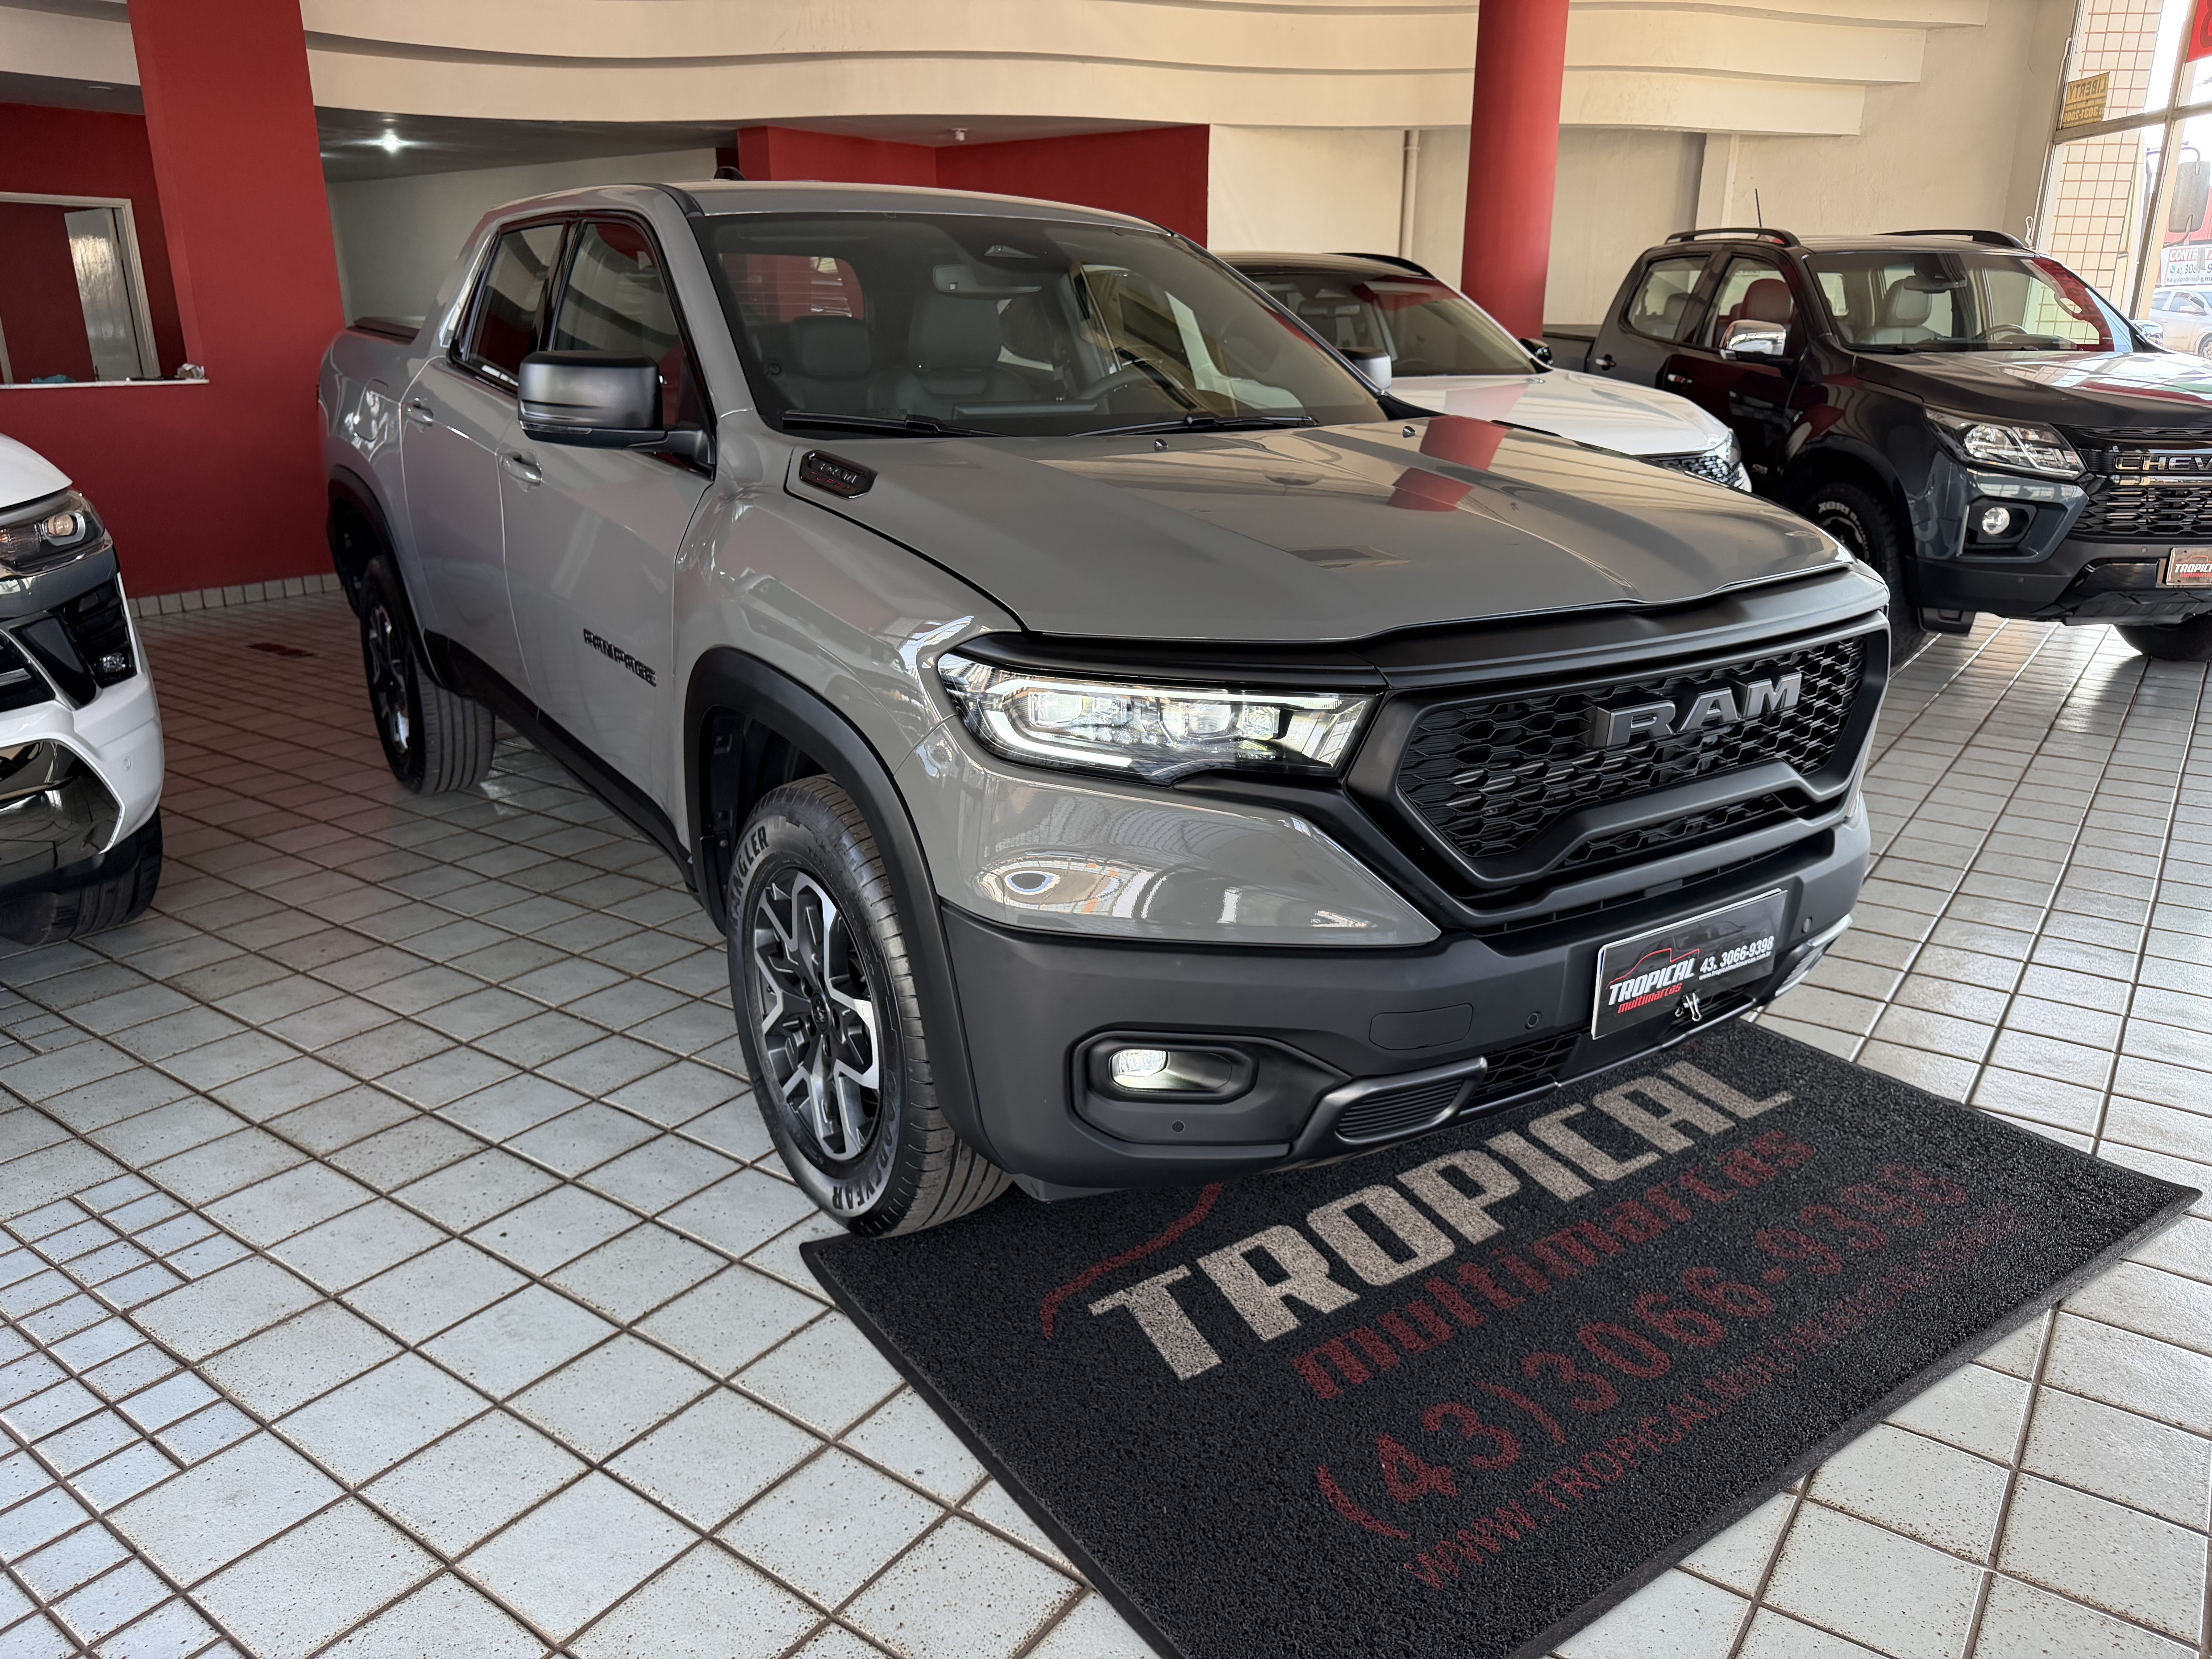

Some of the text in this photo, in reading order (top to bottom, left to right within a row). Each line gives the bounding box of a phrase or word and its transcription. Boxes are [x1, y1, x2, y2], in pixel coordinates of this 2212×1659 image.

[583, 628, 657, 687] RAMPAGE
[1594, 669, 1803, 747] RAM
[1608, 957, 1696, 1006] TROPICAL
[1700, 935, 1775, 973] 43. 3066-9398
[1617, 982, 1683, 1014] multimarcas
[1088, 1060, 1795, 1382] TROPICAL
[1291, 1128, 1815, 1401] multimarcas
[1316, 1163, 1968, 1540] (43)3066-9398
